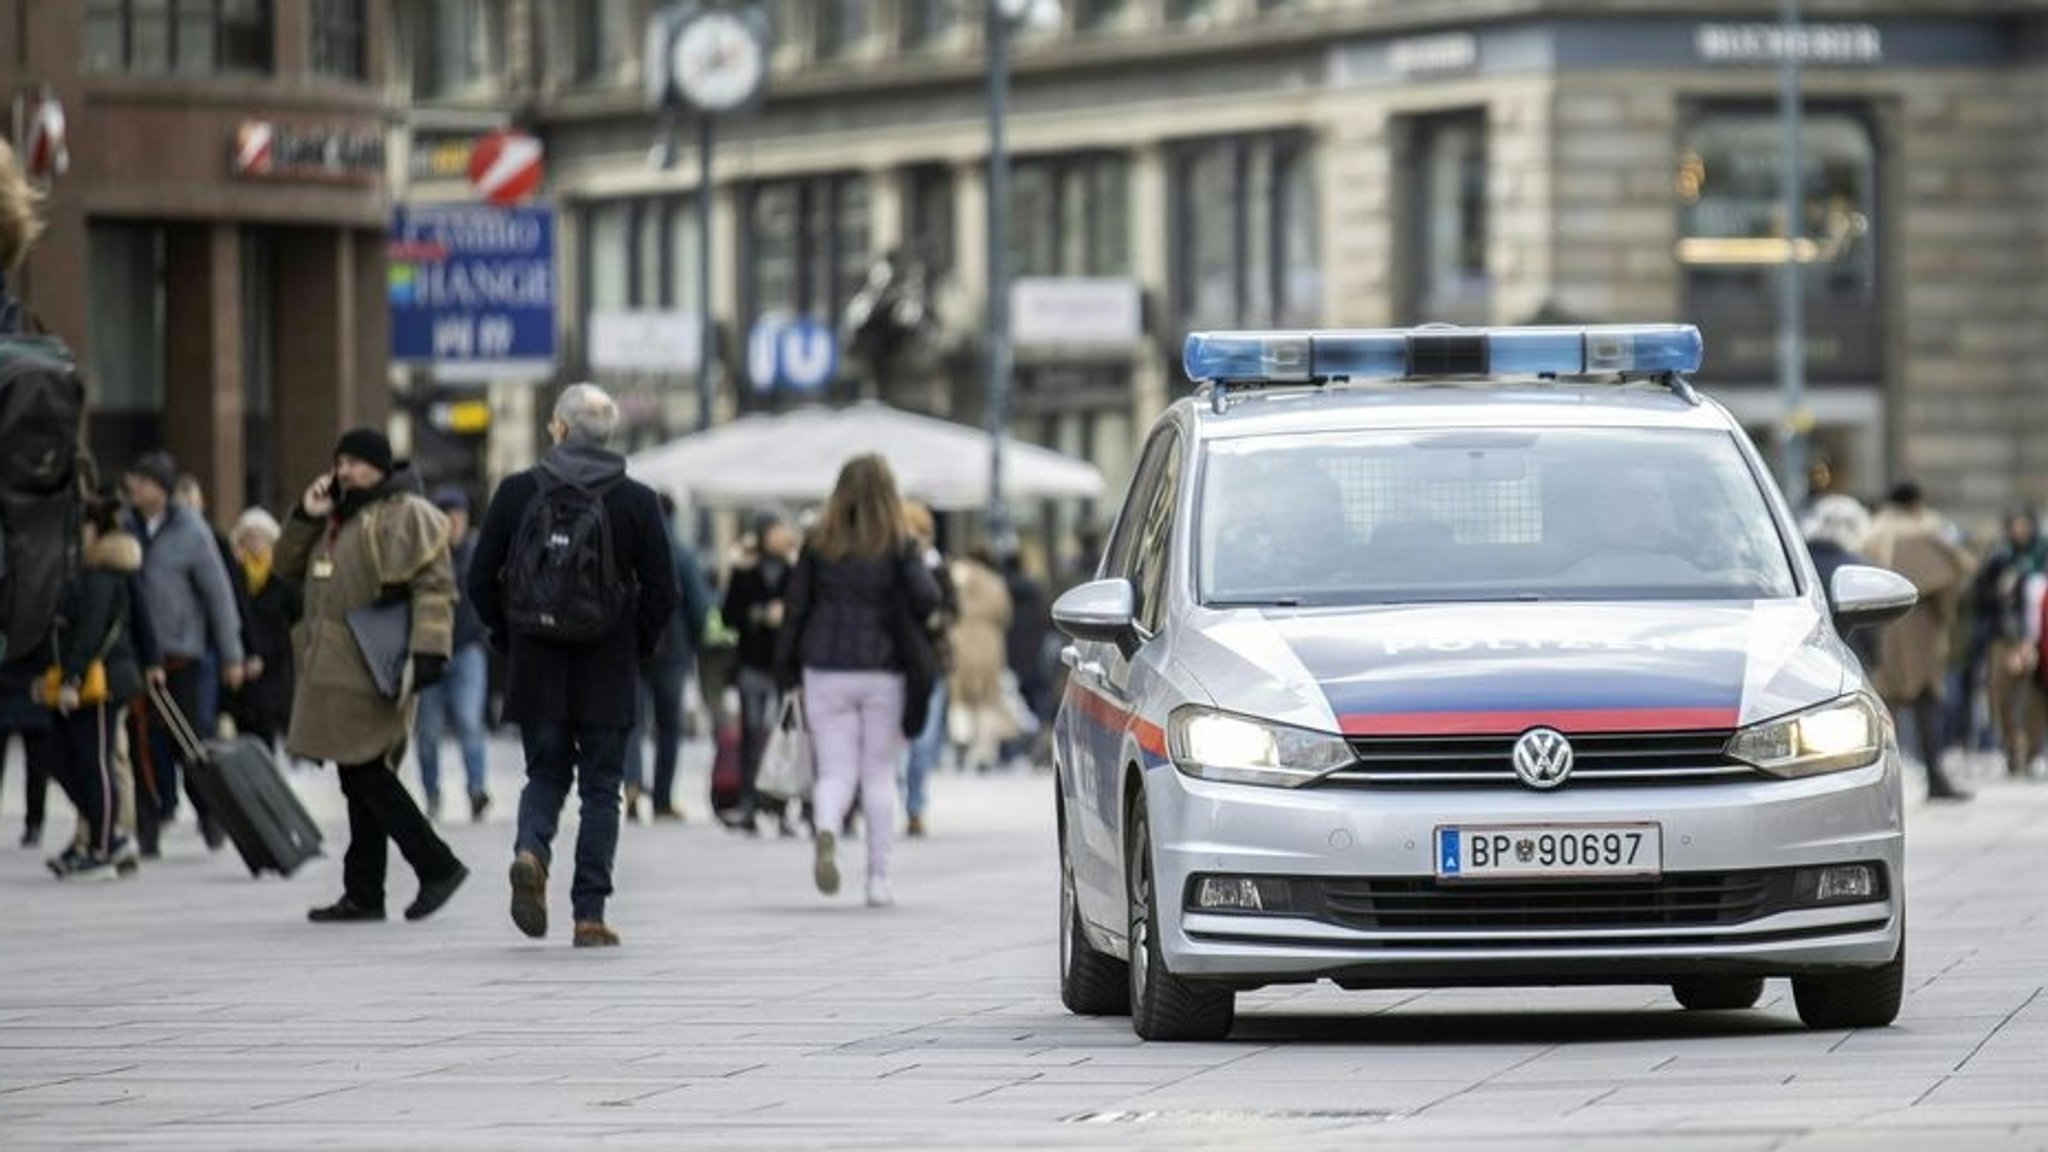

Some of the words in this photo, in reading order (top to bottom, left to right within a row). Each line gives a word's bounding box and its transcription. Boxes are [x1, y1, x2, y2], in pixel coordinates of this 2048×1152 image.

[413, 260, 550, 305] HANGE
[1471, 835, 1510, 867] BP
[1538, 833, 1642, 866] 90697
